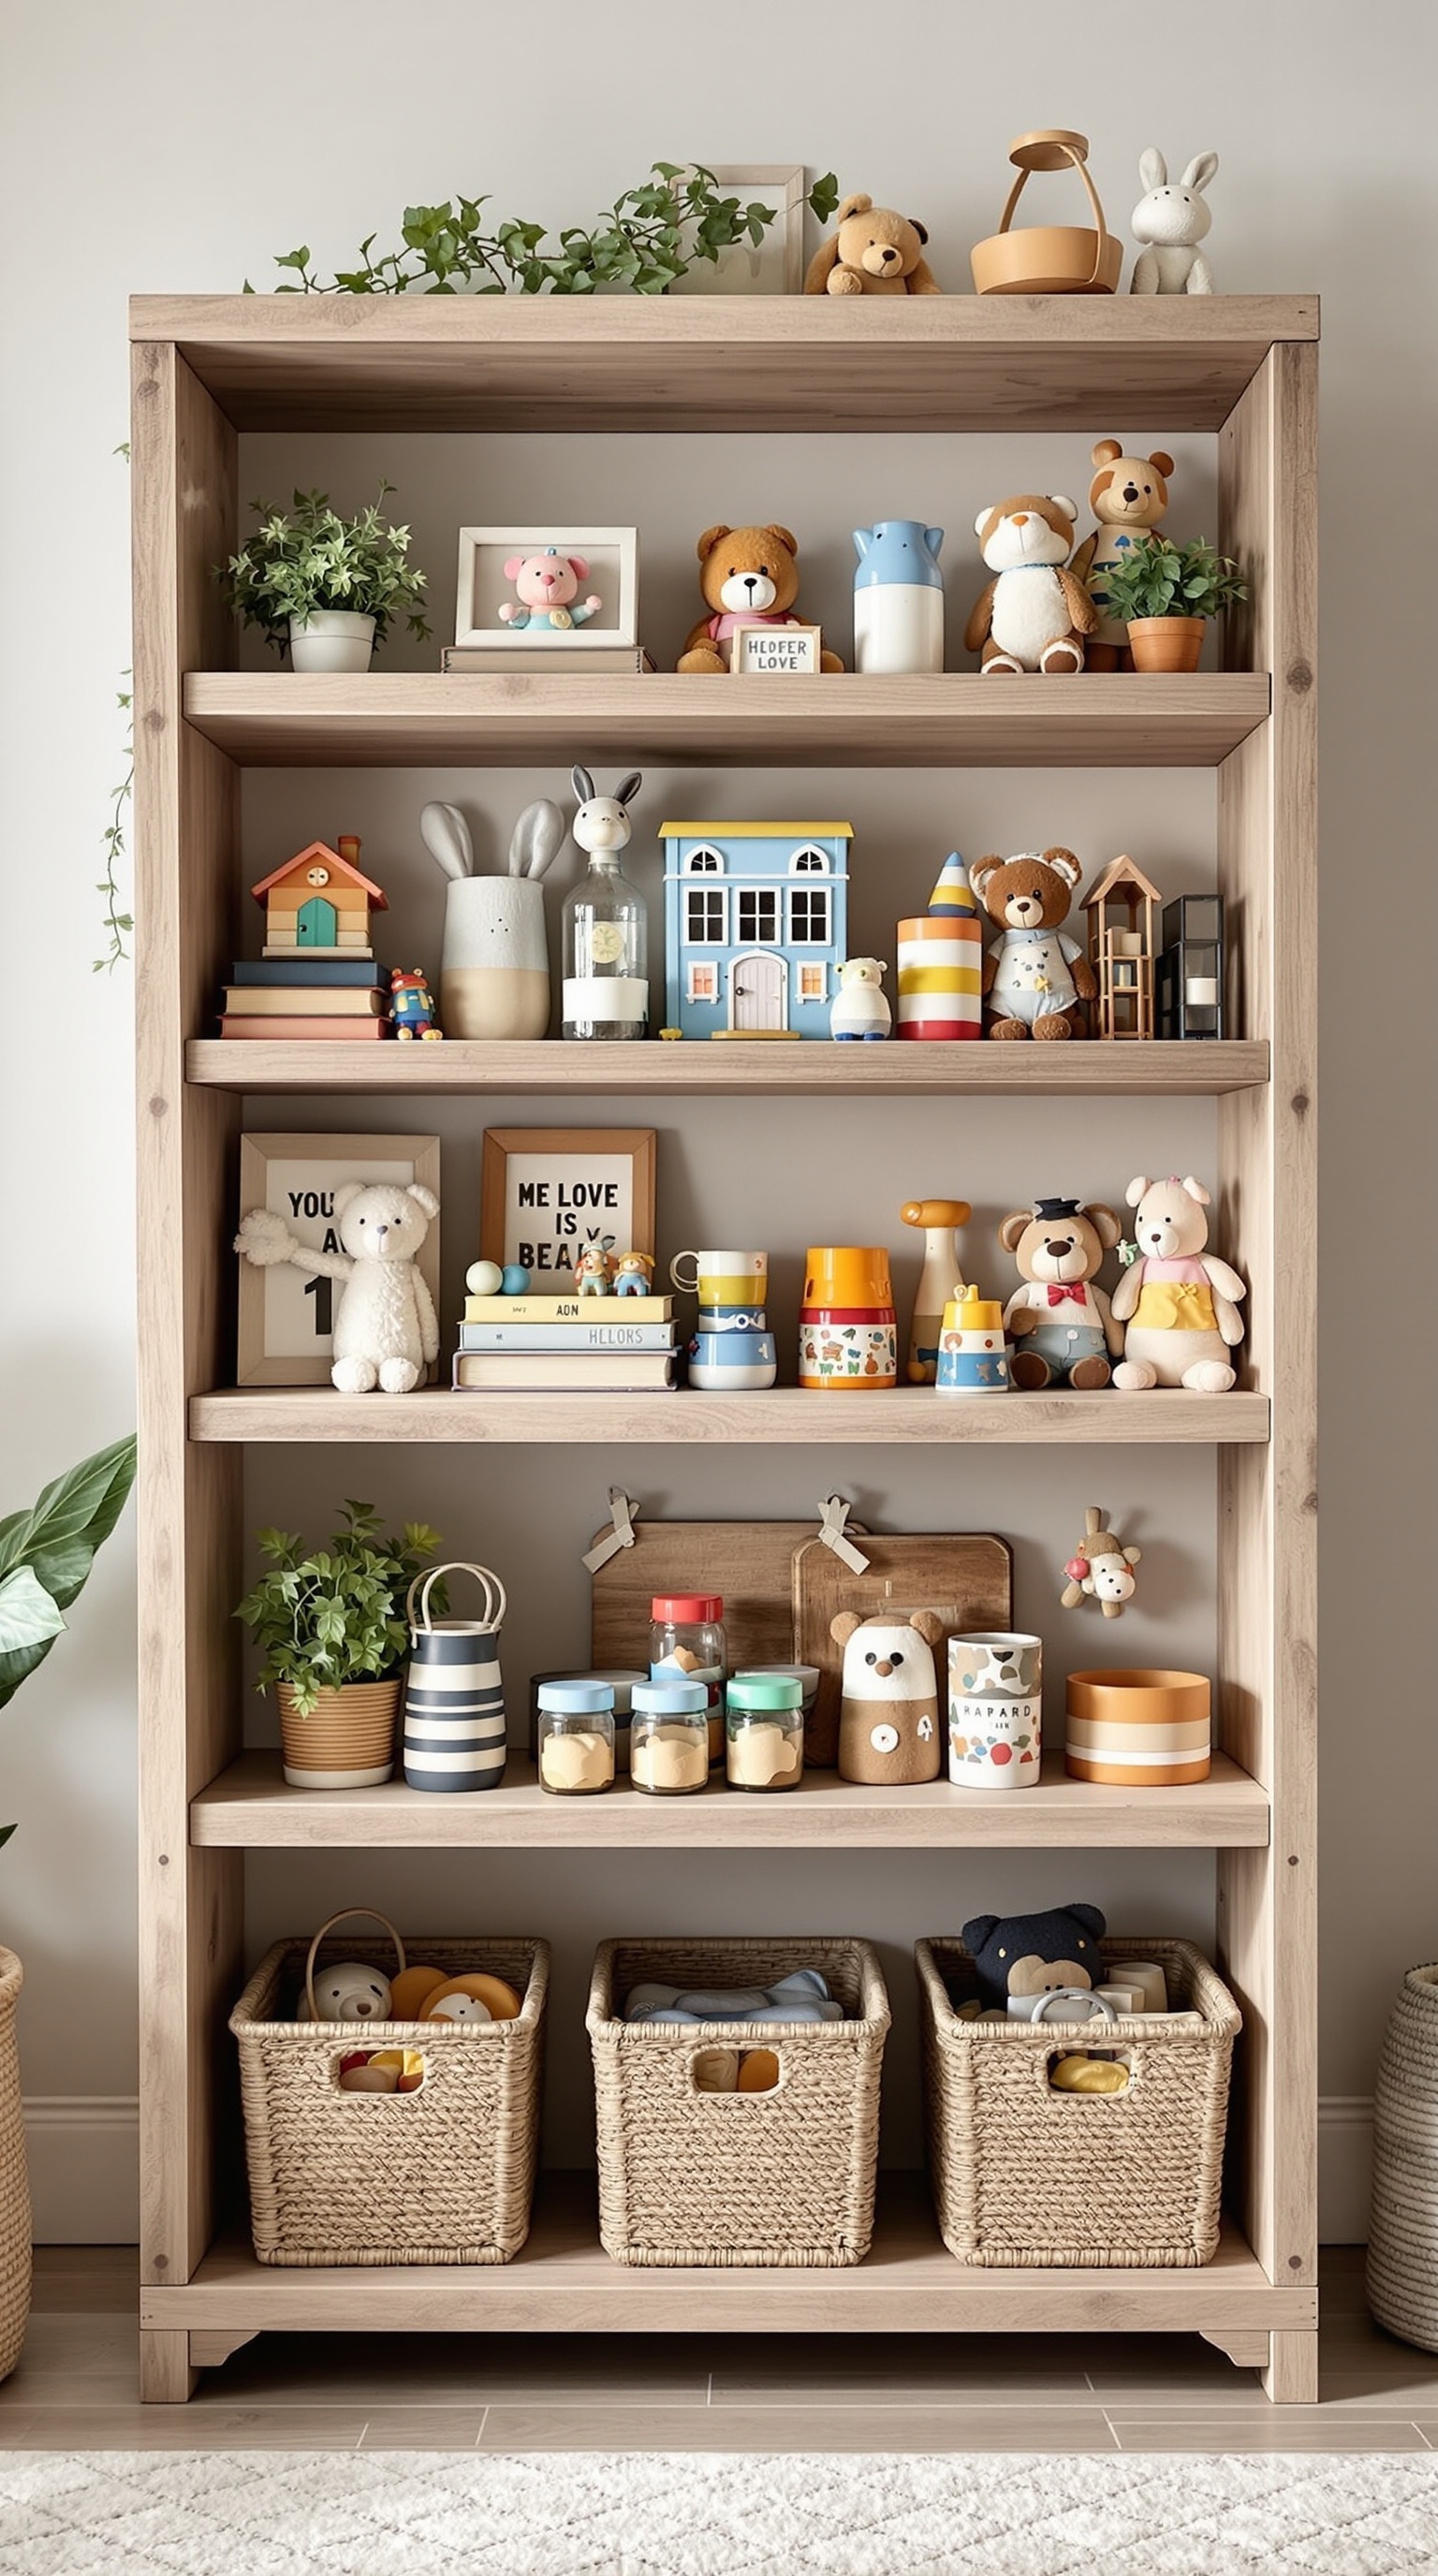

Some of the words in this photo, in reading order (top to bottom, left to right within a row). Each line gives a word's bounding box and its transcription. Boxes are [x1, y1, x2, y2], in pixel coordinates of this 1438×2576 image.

[758, 656, 799, 669] LOVE
[519, 1183, 550, 1208] ME
[558, 1183, 618, 1208] LOVE
[556, 1212, 578, 1235] IS
[519, 1242, 584, 1270] BEA
